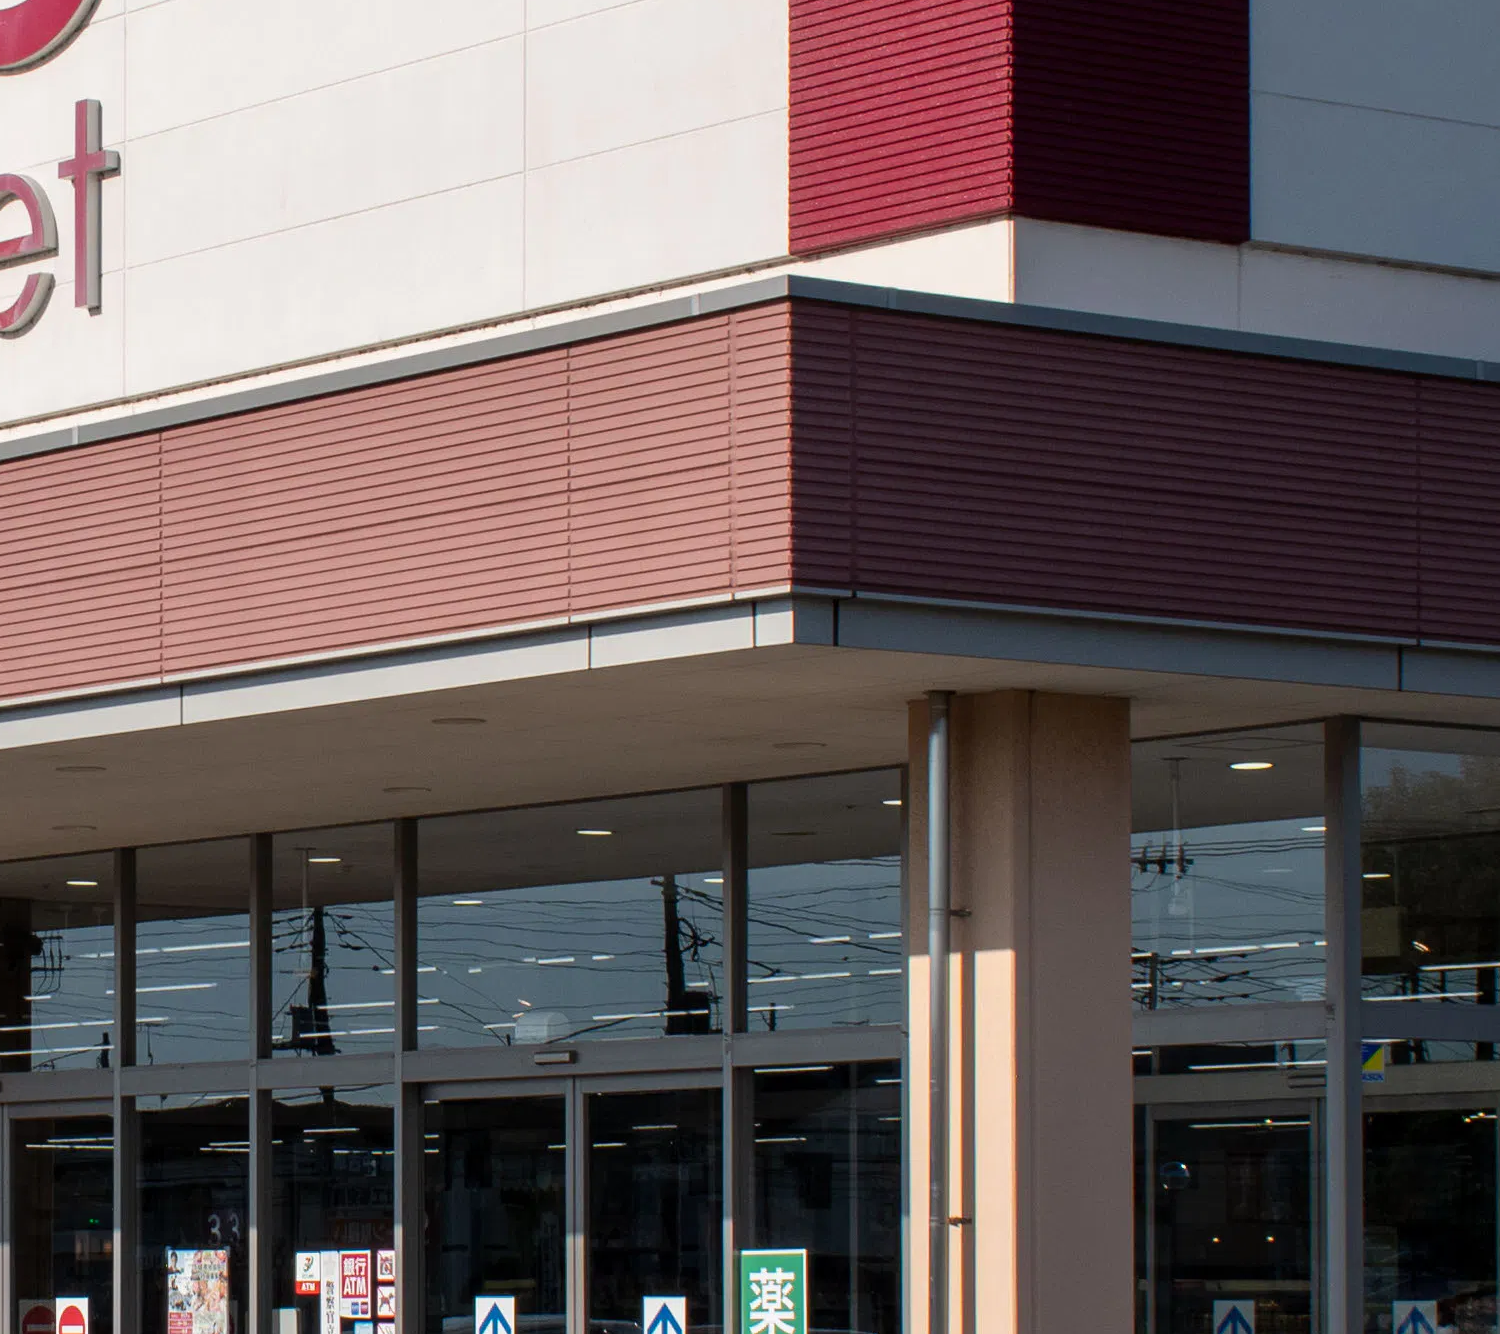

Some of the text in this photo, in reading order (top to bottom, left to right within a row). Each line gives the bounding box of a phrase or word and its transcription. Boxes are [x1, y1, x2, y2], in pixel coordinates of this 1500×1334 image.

[343, 1257, 367, 1276] 銀行
[301, 1282, 316, 1292] ATM
[343, 1276, 368, 1296] ATM
